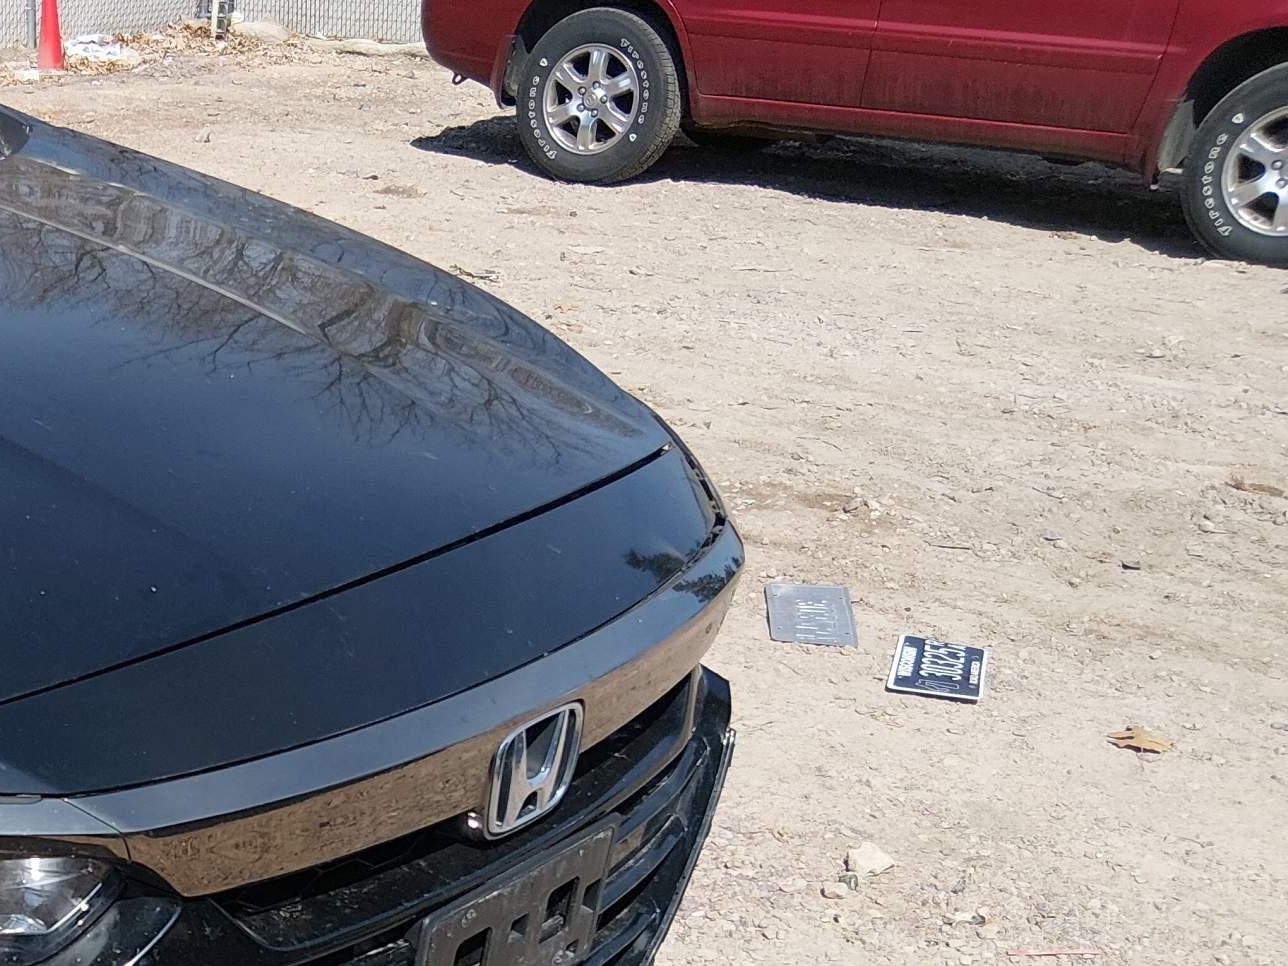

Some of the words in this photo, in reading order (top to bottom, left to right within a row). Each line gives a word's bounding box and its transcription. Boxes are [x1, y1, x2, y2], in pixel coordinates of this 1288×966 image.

[527, 75, 558, 159] Firestone
[620, 38, 649, 124] Firestone
[1202, 133, 1232, 236] Firestone
